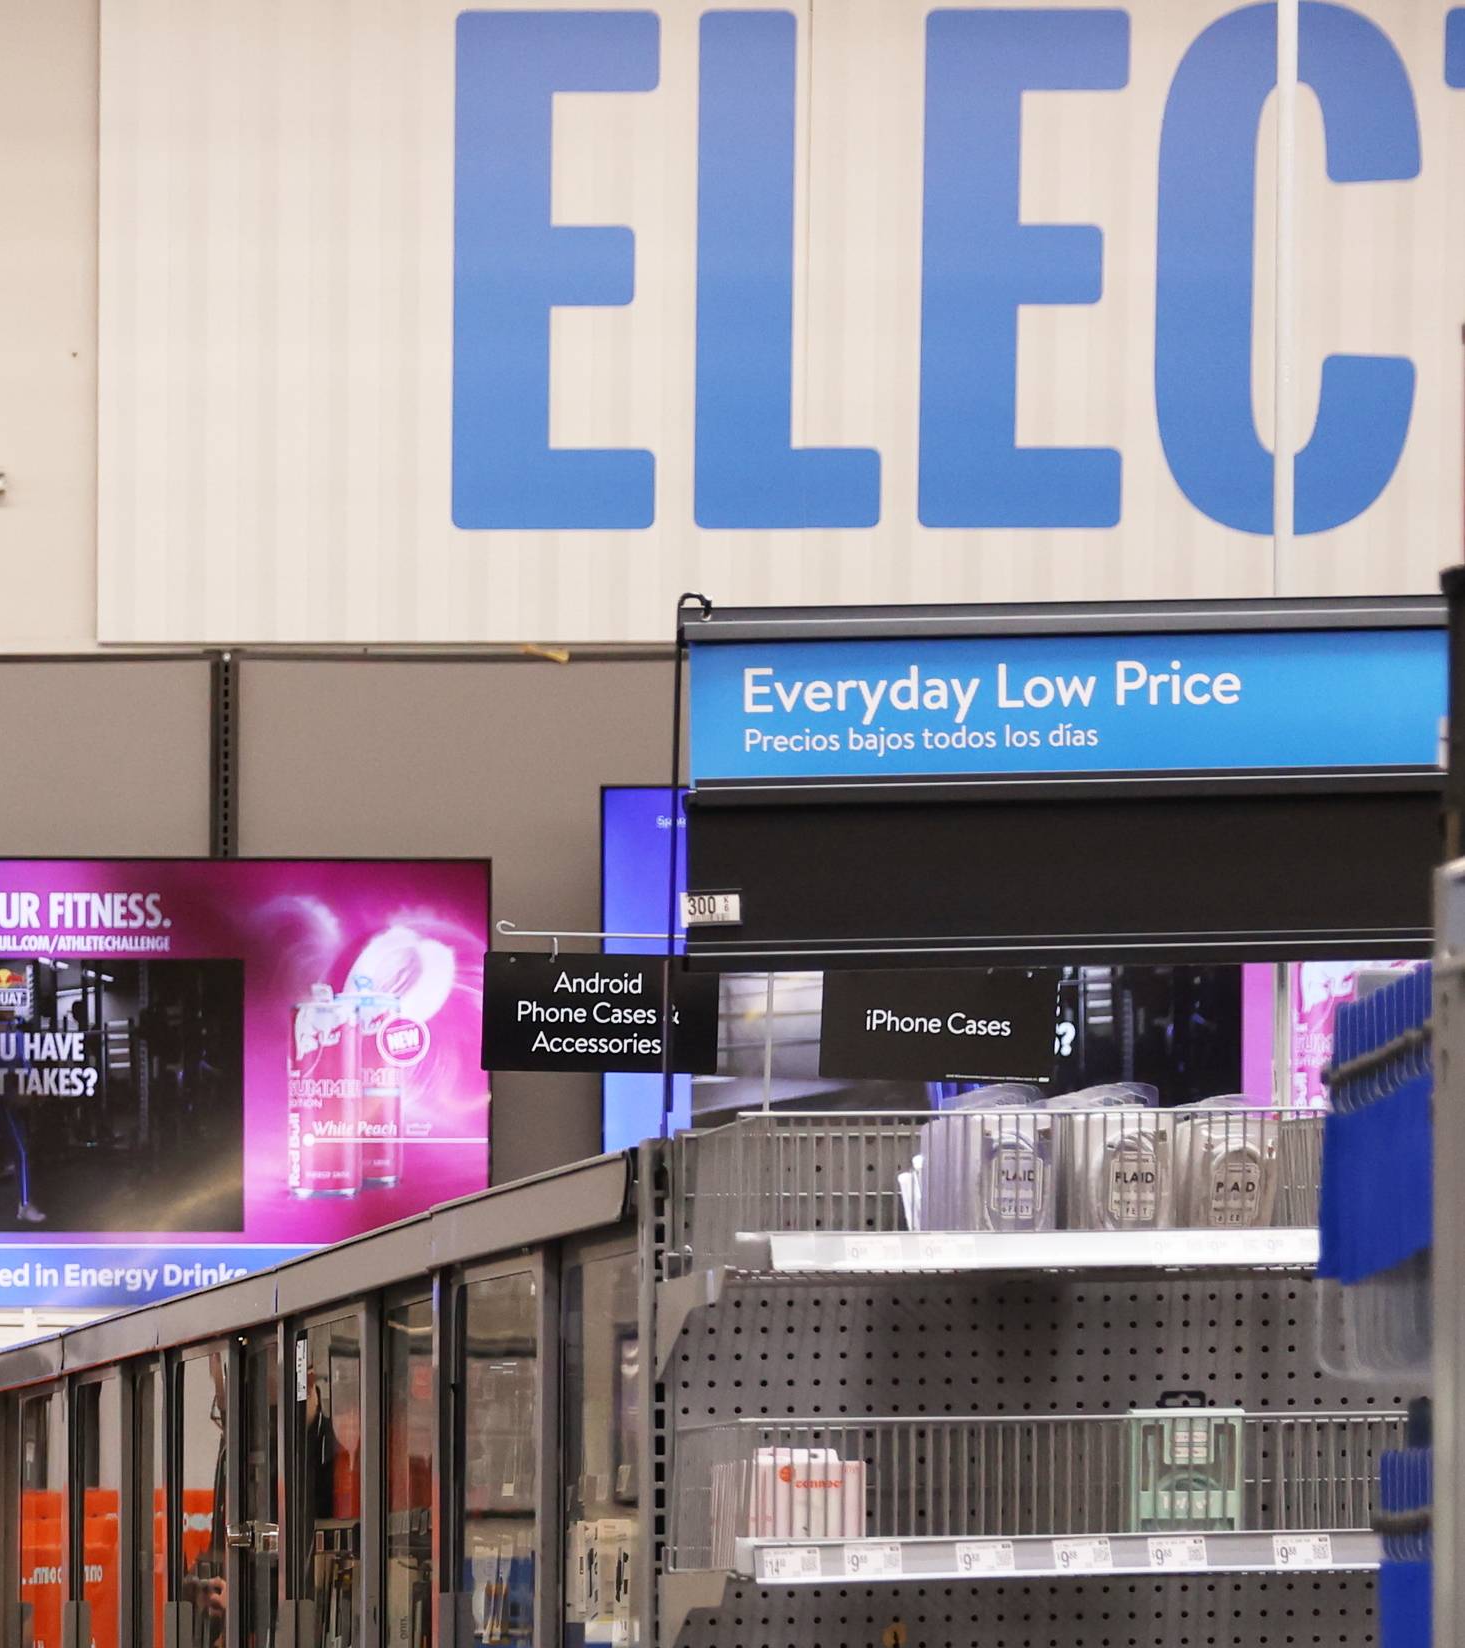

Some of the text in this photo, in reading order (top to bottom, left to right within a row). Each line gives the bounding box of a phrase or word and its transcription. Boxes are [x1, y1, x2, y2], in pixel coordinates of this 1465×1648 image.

[450, 0, 1465, 537] ELEC
[743, 660, 1243, 725] Everyday Low Price
[744, 723, 1099, 758] Precios bajos todos los días
[48, 892, 172, 929] FITNESS.
[688, 895, 717, 916] 300
[553, 970, 643, 995] Android
[516, 1001, 586, 1025] Phone
[592, 1001, 658, 1025] Cases
[865, 1009, 1012, 1038] iPhone Cases
[23, 1032, 85, 1062] HAVE
[386, 1027, 420, 1052] NEW
[530, 1030, 663, 1056] Accessories
[15, 1067, 98, 1097] TAKES?
[312, 1120, 354, 1137] White
[357, 1120, 398, 1137] Peach
[35, 1262, 59, 1288] in
[63, 1262, 159, 1291] Energy
